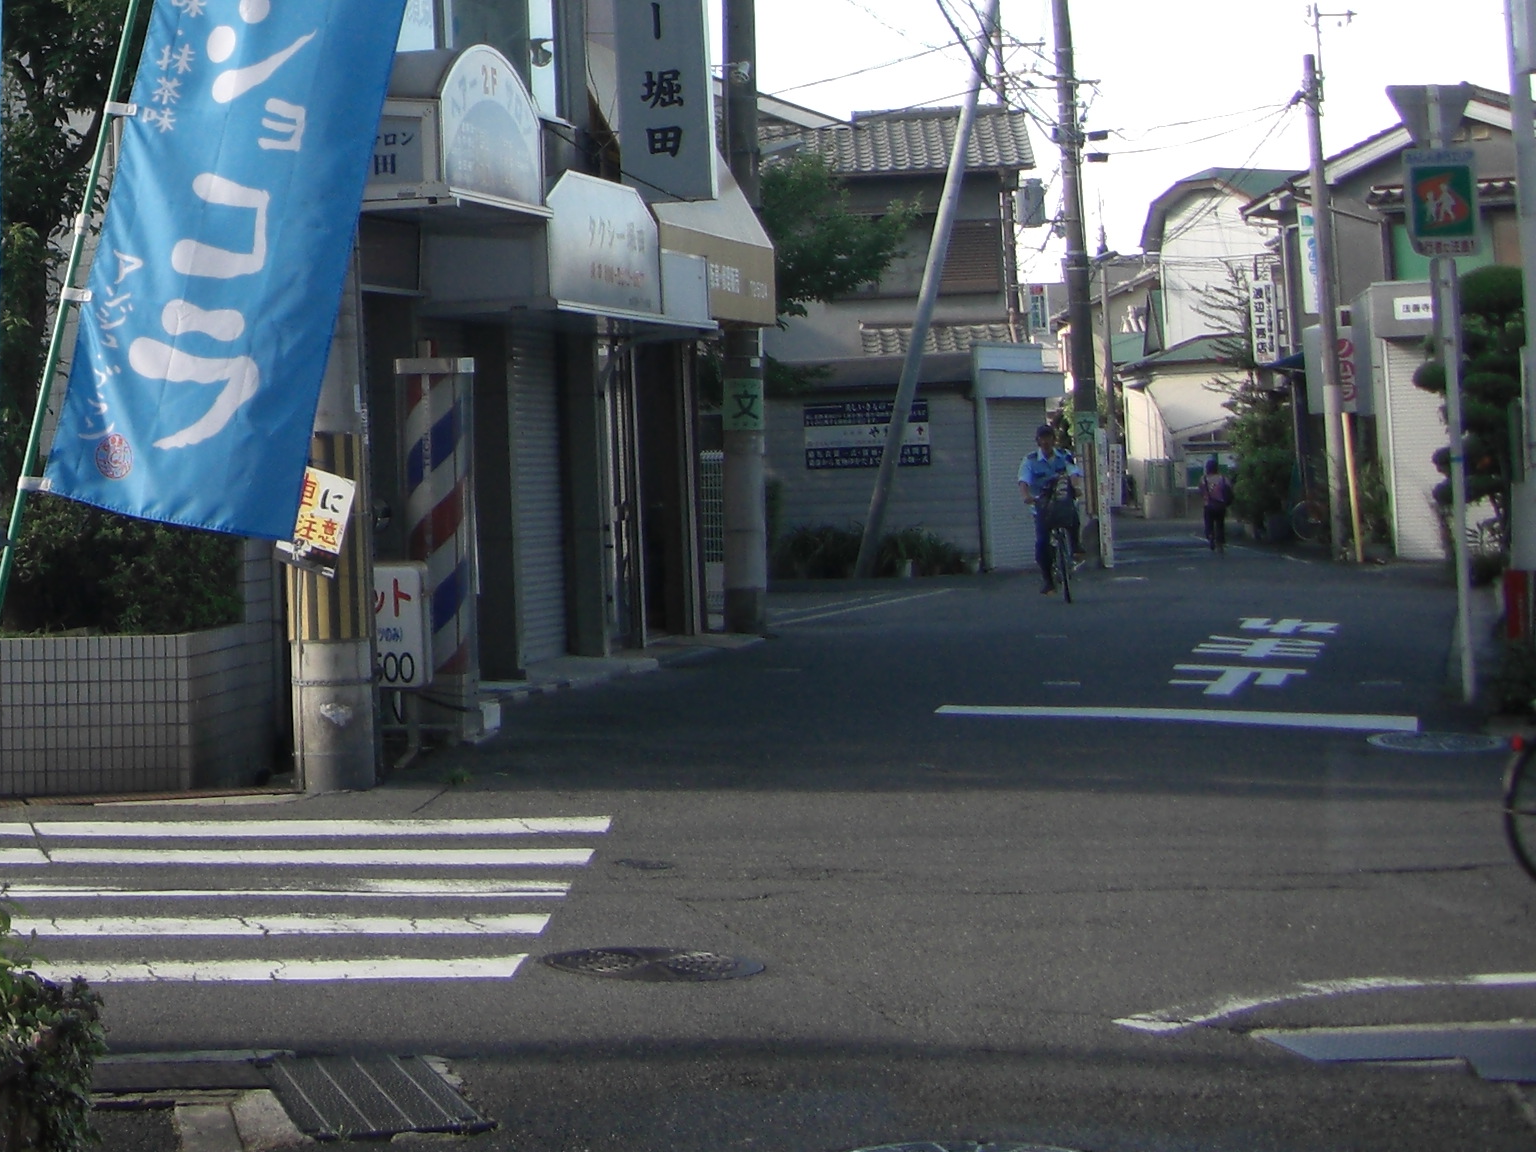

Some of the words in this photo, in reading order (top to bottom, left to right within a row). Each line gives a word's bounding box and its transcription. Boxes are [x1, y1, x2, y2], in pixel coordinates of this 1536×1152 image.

[481, 63, 498, 98] 2F
[640, 69, 684, 158] 堀田
[731, 389, 759, 420] 文
[1076, 418, 1094, 437] 文
[294, 513, 338, 547] 注意
[1167, 616, 1341, 696] 止まれ
